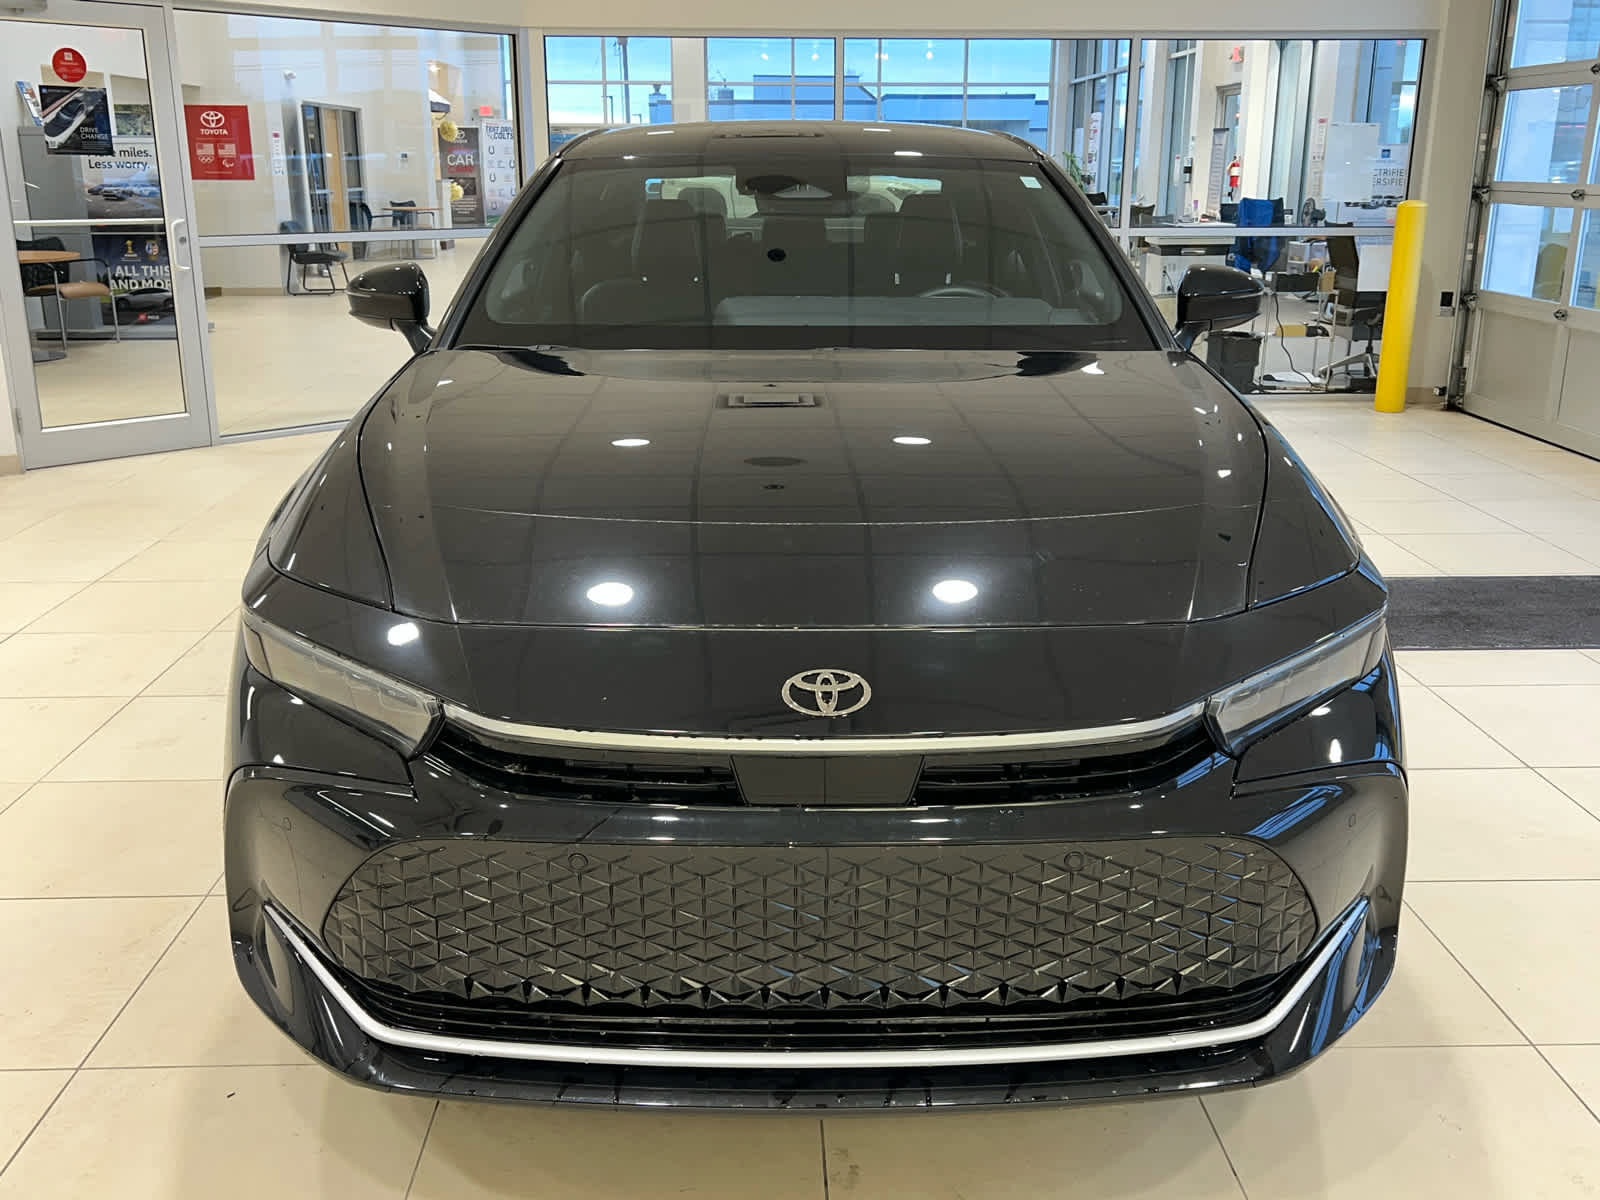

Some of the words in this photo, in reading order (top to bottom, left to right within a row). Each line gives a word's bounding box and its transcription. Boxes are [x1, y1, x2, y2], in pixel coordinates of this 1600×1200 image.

[199, 127, 229, 136] TOYOTA
[119, 146, 153, 158] miles.
[88, 159, 113, 169] Less
[114, 161, 151, 172] worry.
[447, 154, 474, 167] CAR
[115, 265, 140, 278] ALL
[111, 279, 139, 291] AND
